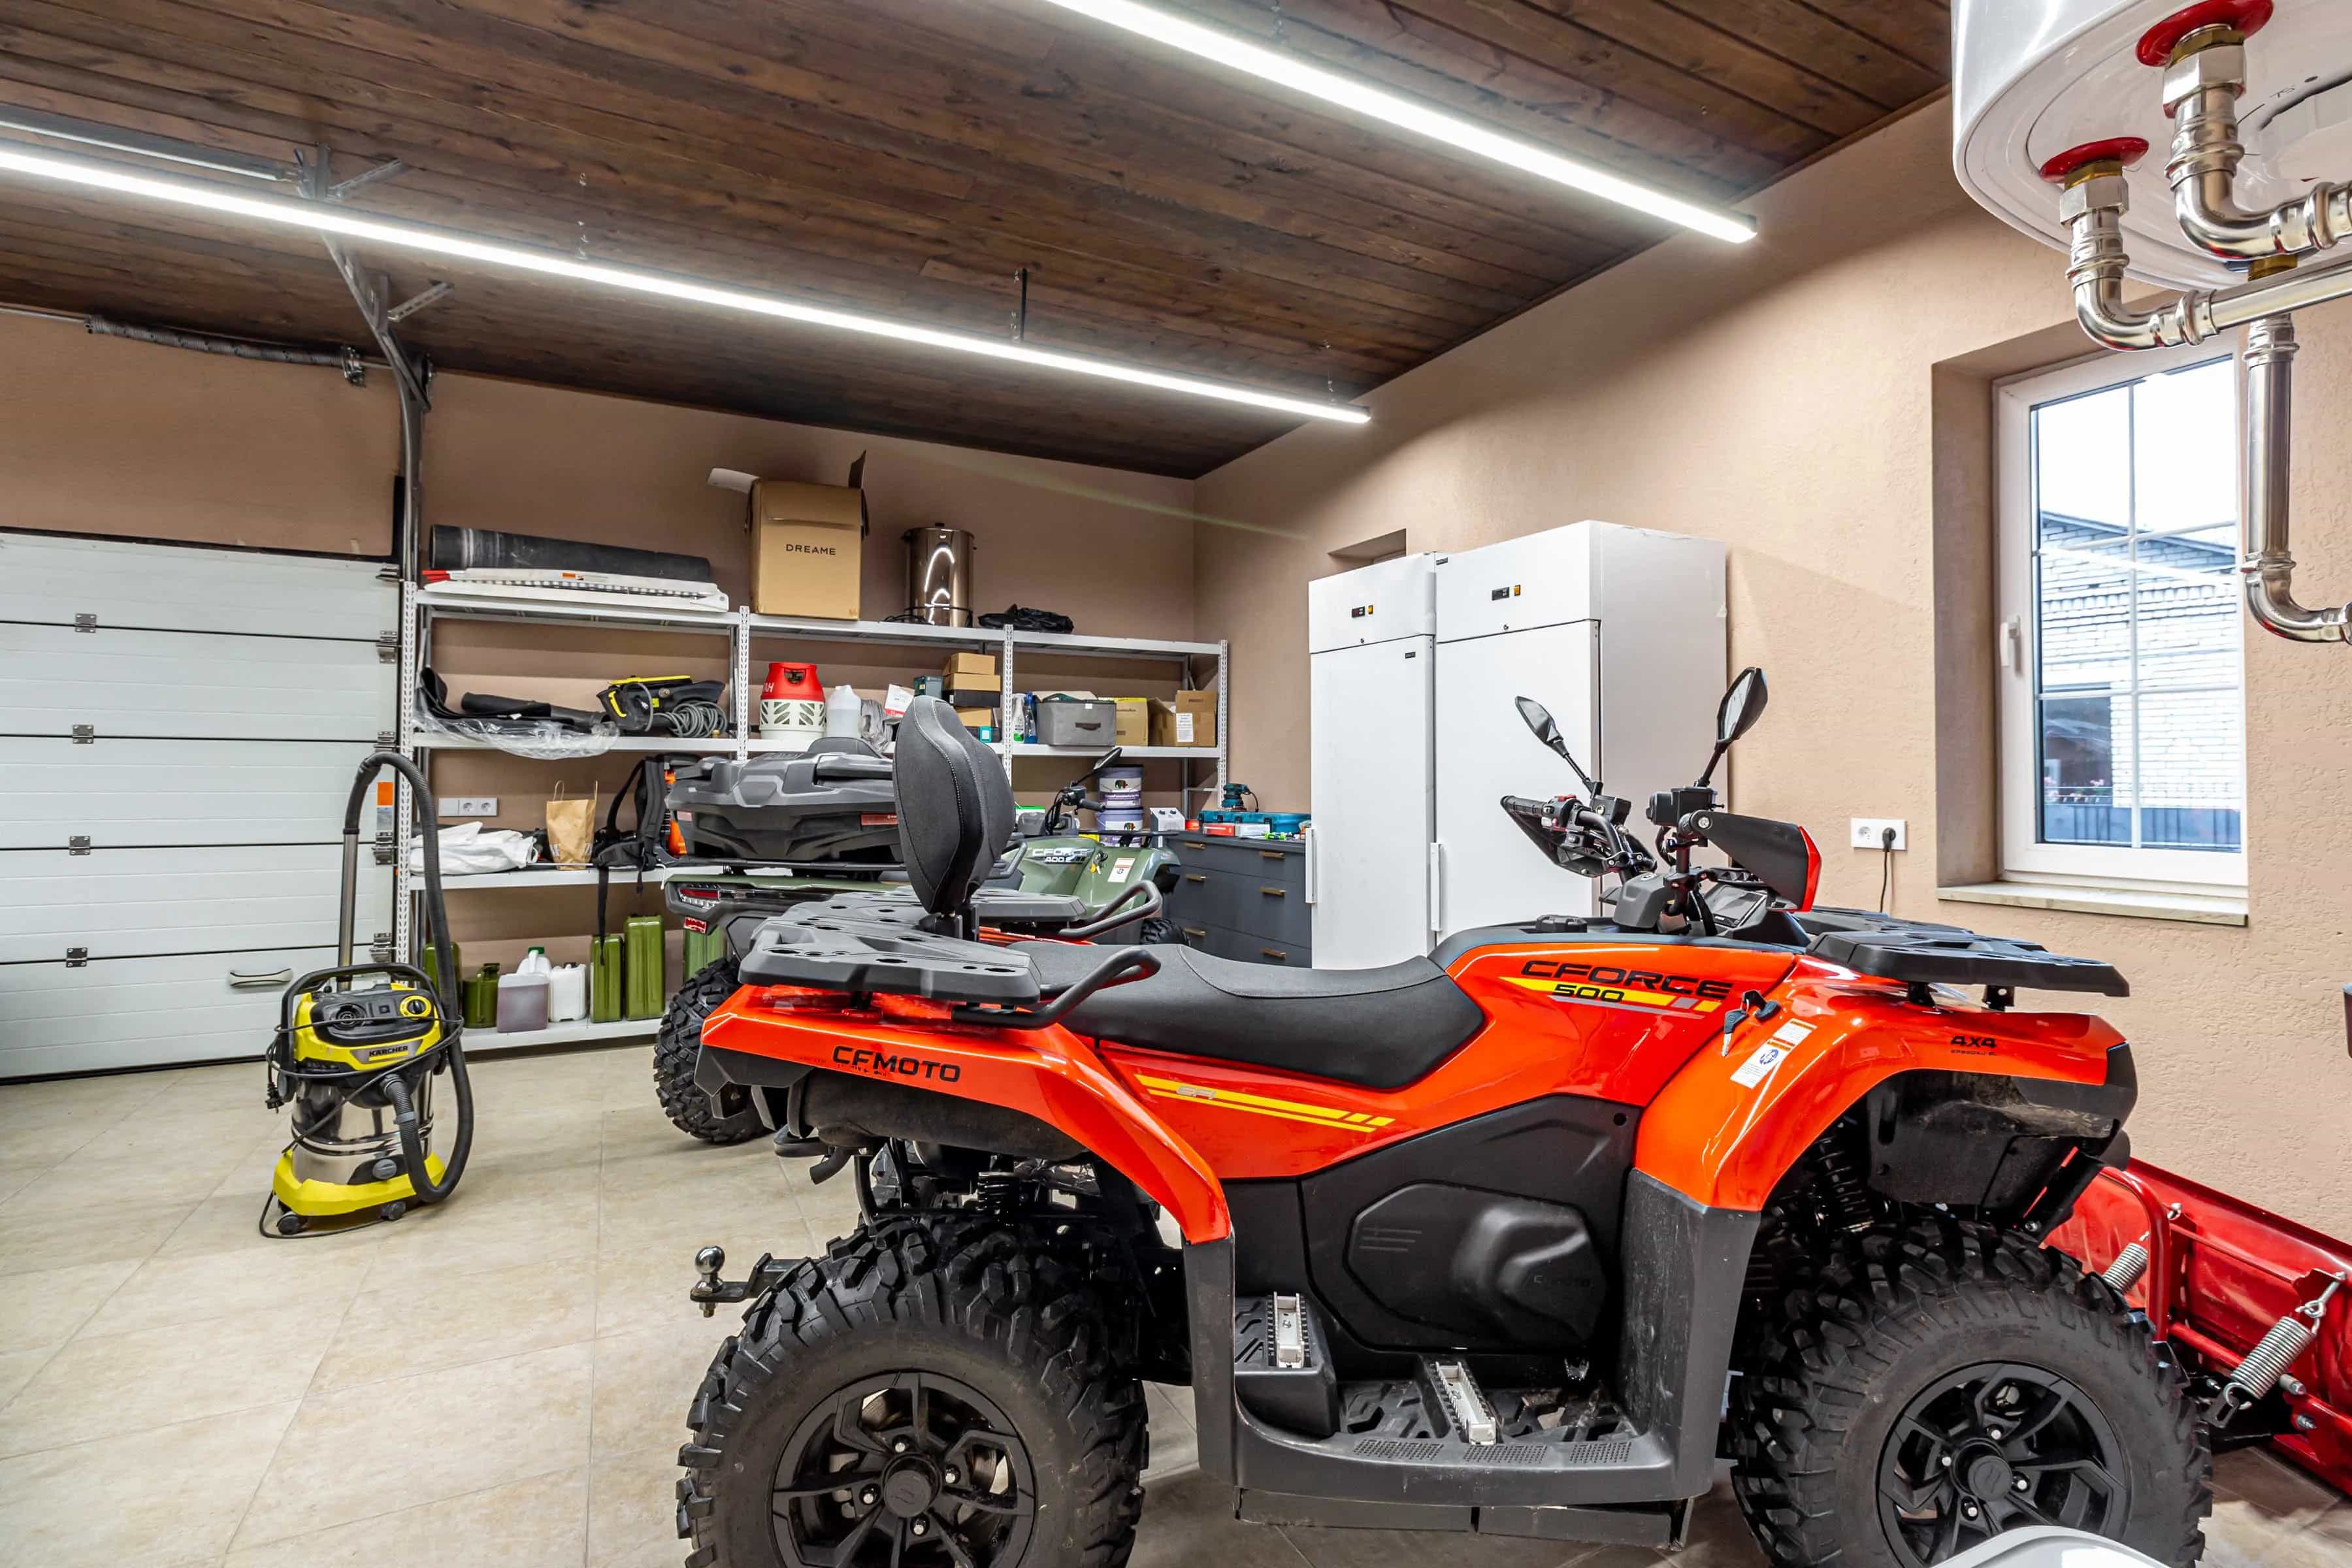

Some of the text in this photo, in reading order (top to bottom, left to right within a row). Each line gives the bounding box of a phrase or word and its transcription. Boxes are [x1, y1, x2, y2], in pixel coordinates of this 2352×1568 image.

[785, 544, 837, 555] DREAME
[1521, 960, 1734, 1000] CFORCE
[1552, 983, 1625, 1003] 500
[832, 1045, 961, 1083] CFMOTO
[1177, 1086, 1215, 1100] EFI
